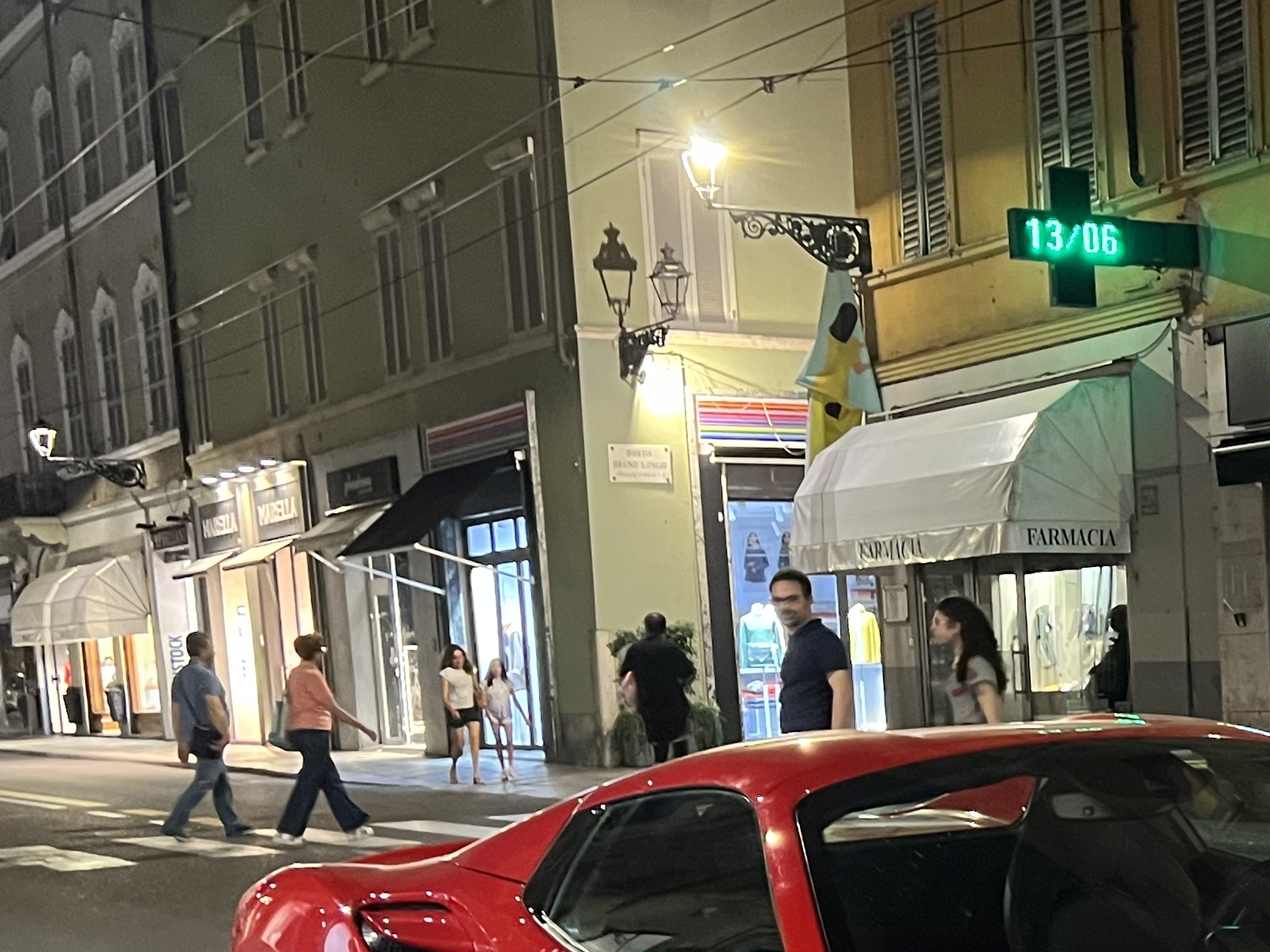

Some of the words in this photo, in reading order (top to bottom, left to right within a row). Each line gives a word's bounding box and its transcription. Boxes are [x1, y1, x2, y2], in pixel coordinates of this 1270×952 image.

[1025, 218, 1120, 256] 13/06
[1027, 526, 1117, 547] FARMACIA
[859, 538, 923, 560] FARMACIA
